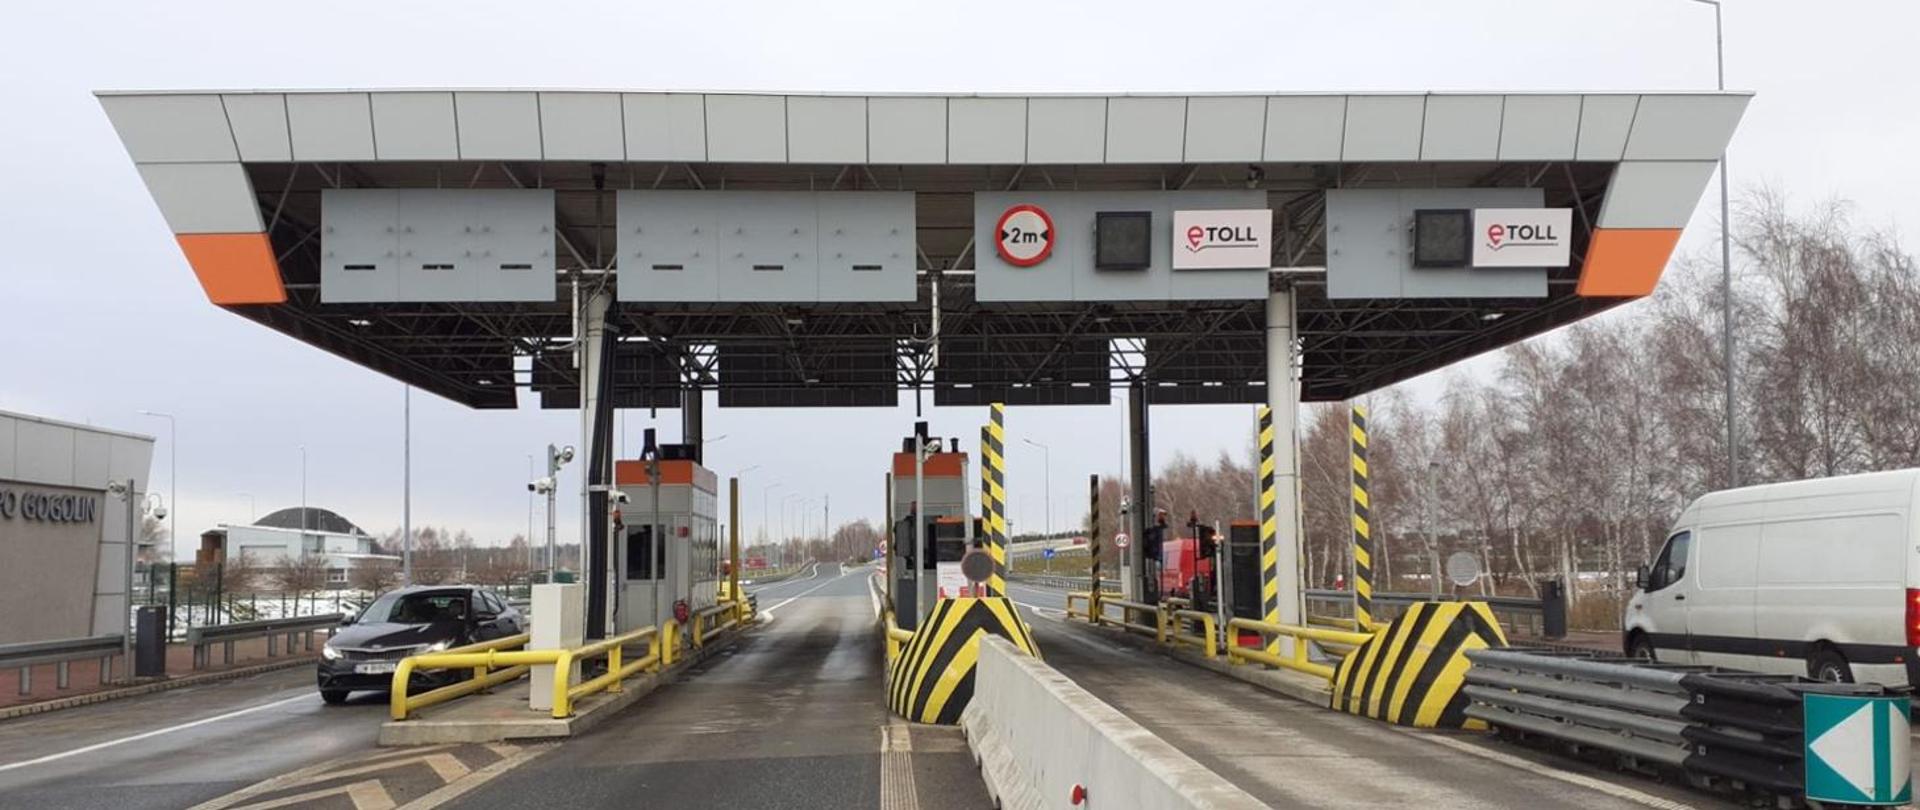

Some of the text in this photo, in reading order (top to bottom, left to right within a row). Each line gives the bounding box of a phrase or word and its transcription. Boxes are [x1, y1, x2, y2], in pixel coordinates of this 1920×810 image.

[1010, 227, 1038, 244] 2m
[1187, 225, 1257, 247] eTOLL
[1487, 224, 1557, 246] eTOLL
[23, 491, 96, 523] GOGOLIN
[1116, 536, 1128, 545] 60
